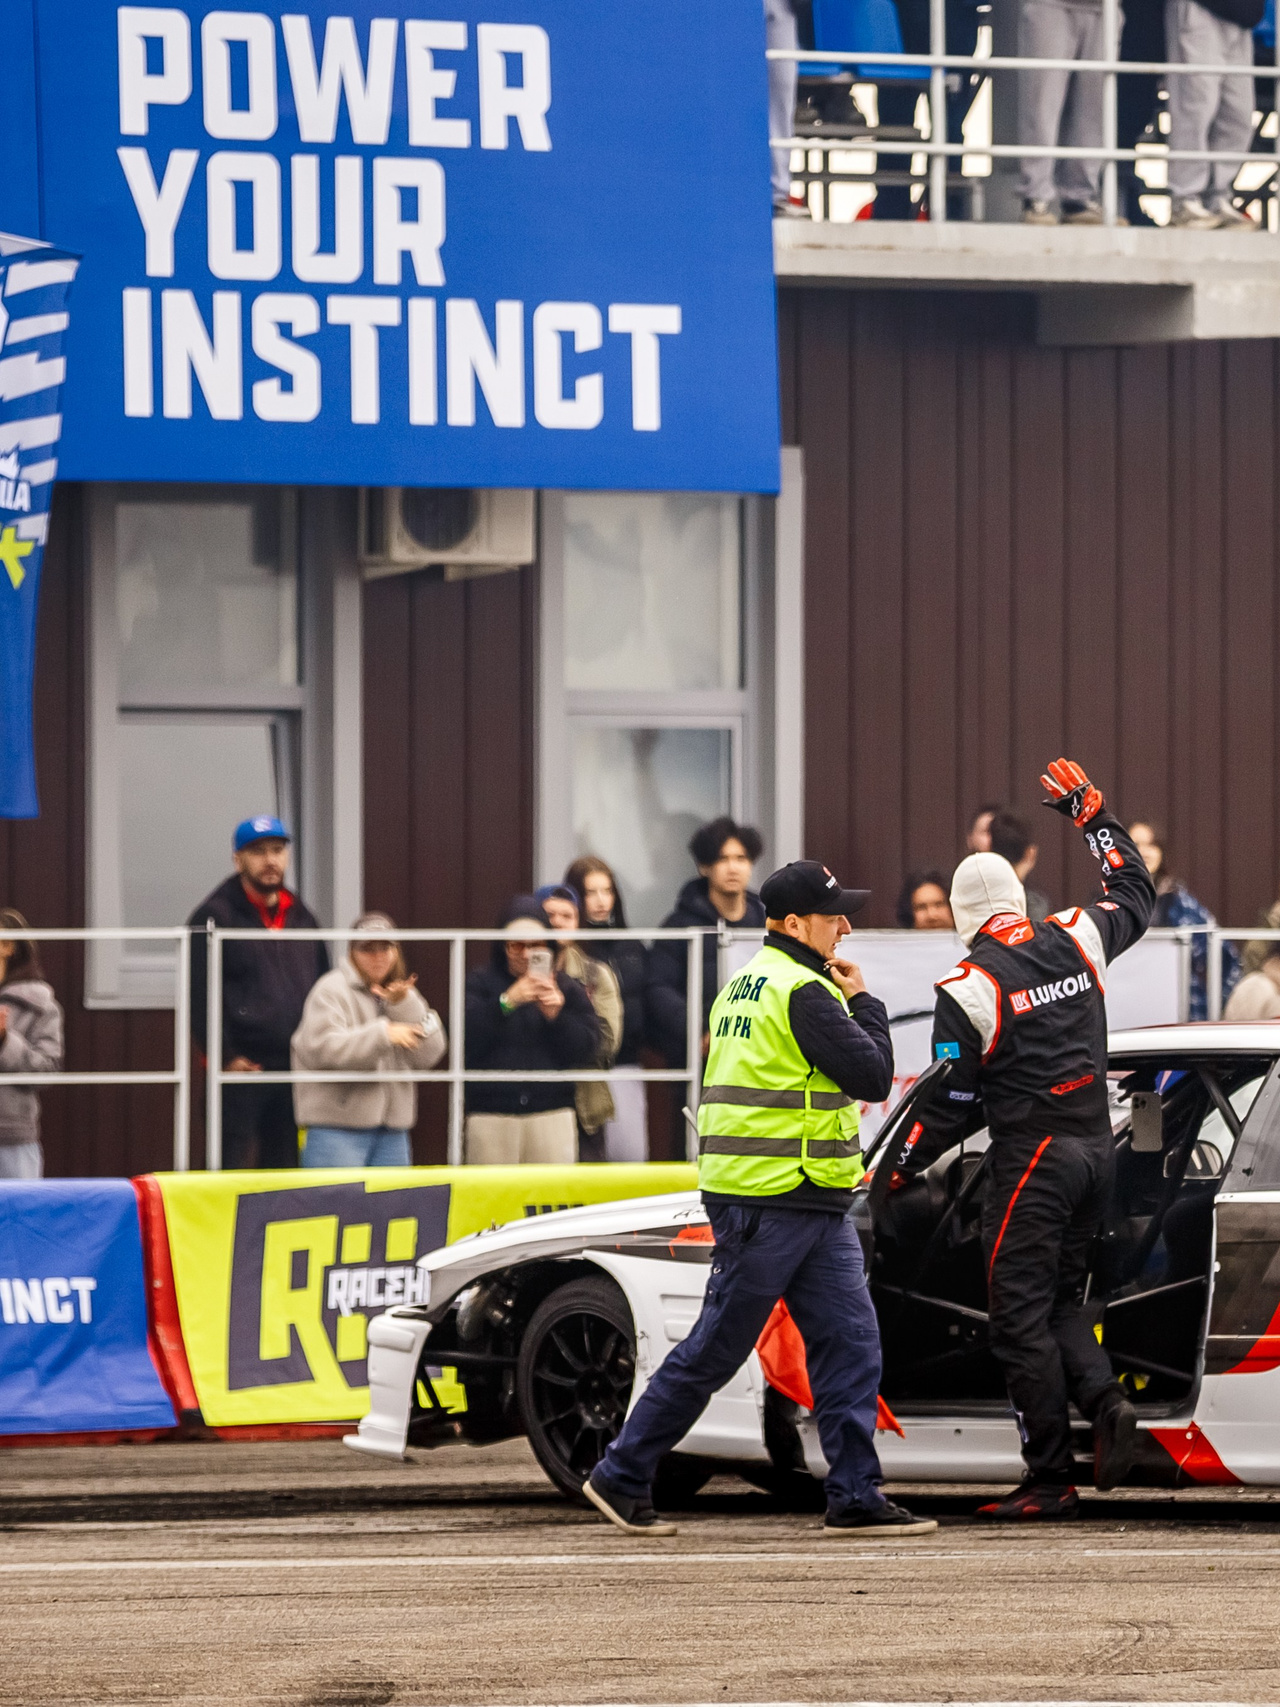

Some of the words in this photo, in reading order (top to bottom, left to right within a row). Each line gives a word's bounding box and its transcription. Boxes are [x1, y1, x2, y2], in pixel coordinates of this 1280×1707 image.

[117, 6, 552, 152] POWER
[117, 146, 446, 287] YOUR
[122, 287, 682, 432] INSTINCT
[1028, 971, 1092, 1007] LUKOIL
[0, 1276, 97, 1324] INCT
